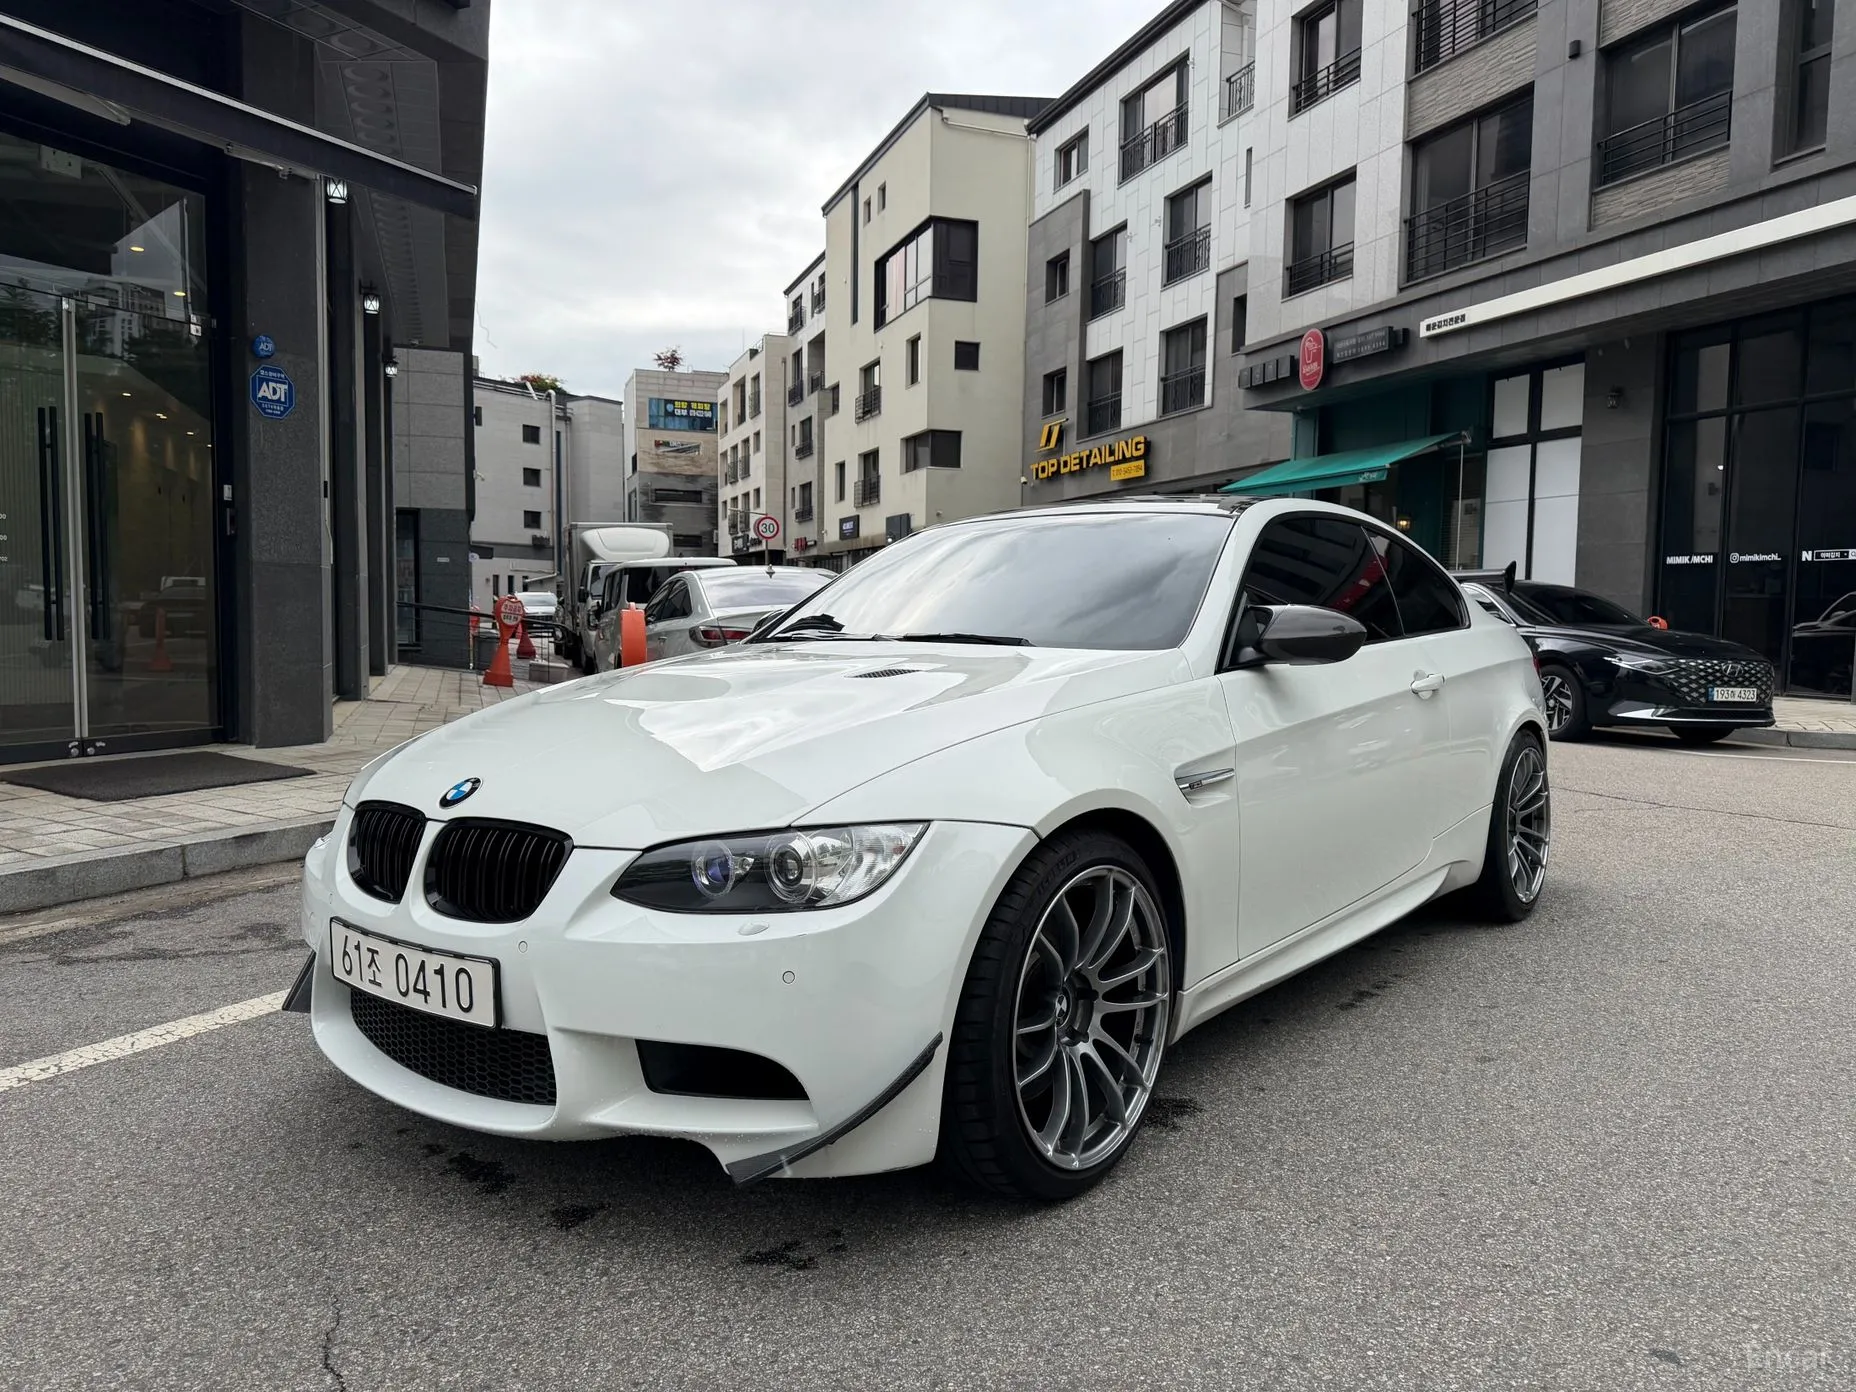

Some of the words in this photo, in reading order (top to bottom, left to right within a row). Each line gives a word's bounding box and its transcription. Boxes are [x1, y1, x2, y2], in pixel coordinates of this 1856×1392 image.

[257, 381, 288, 402] ADT
[1030, 458, 1058, 480] TOP
[1060, 435, 1145, 474] DETAILING
[761, 522, 775, 534] 30
[1801, 550, 1813, 562] N
[1737, 689, 1756, 700] 4323
[342, 935, 383, 987] 61조
[395, 953, 474, 1013] 0410
